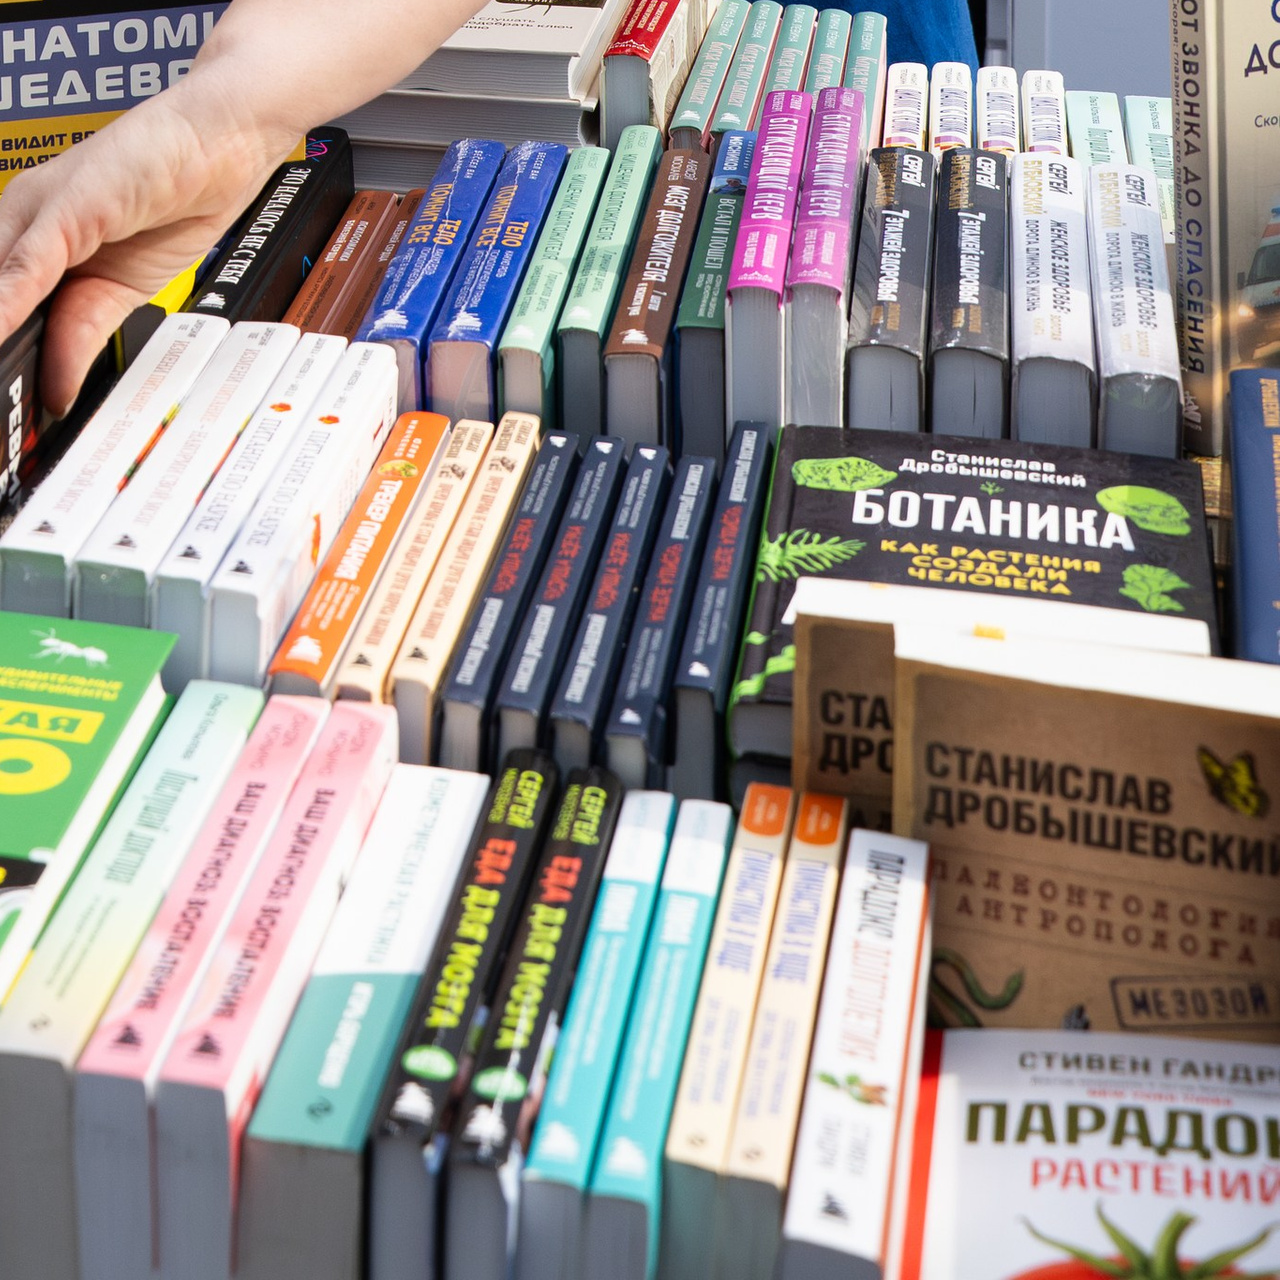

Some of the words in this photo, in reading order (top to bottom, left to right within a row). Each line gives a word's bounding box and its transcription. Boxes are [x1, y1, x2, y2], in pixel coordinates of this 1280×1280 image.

[1181, 42, 1202, 160] ЗВОНКА
[0, 132, 69, 153] ВИДИТ
[723, 136, 744, 171] МЯСНИКОВ
[757, 117, 798, 192] БЛУЖДАЮЩИЙ
[812, 114, 851, 188] БЛУЖДАЮЩИЙ
[282, 166, 312, 185] ЭТО
[976, 156, 1001, 190] СЕРГЕЙ
[1048, 162, 1072, 195] СЕРГЕЙ
[1183, 166, 1203, 208] ДО
[248, 185, 300, 233] НАЧАЛОСЬ
[485, 184, 518, 226] ПОМНИТ
[669, 185, 690, 212] МОЗГ
[750, 192, 786, 221] НЕРВ
[808, 189, 843, 218] НЕРВ
[238, 234, 268, 250] НЕ
[475, 226, 499, 247] ВСЕ
[501, 220, 529, 248] ТЕЛО
[643, 208, 681, 283] ДОЛГОЖИТЕЛЯ
[960, 220, 985, 255] ЭТАЖЕЙ
[1050, 219, 1069, 261] ЖЕНСКОЕ
[214, 257, 253, 285] ТЕБЯ
[958, 253, 981, 304] ЗДОРОВЬЯ
[1185, 220, 1206, 374] СПАСЕНИЯ
[898, 457, 1087, 488] Дробышевский
[931, 449, 1056, 473] Станислав
[365, 479, 404, 522] ТРЕКЕР
[851, 487, 1136, 552] БОТАНИКА
[333, 520, 382, 581] ПИТАНИЯ
[880, 539, 939, 556] КАК
[950, 545, 1102, 574] РАСТЕНИЯ
[911, 554, 1068, 582] СОЗДАЛИ
[907, 566, 1072, 596] ЧЕЛОВЕКА
[924, 740, 1173, 815] СТАНИСЛАВ
[475, 838, 517, 884] ЕДА
[955, 894, 1257, 968] АНТРОПОЛОГА
[424, 939, 484, 1029] МОЗГА
[1128, 984, 1270, 1021] МЕЗОЗОЙ
[1018, 1051, 1153, 1078] СТИВЕН
[1030, 1156, 1280, 1205] РАСТЕНИЙ
